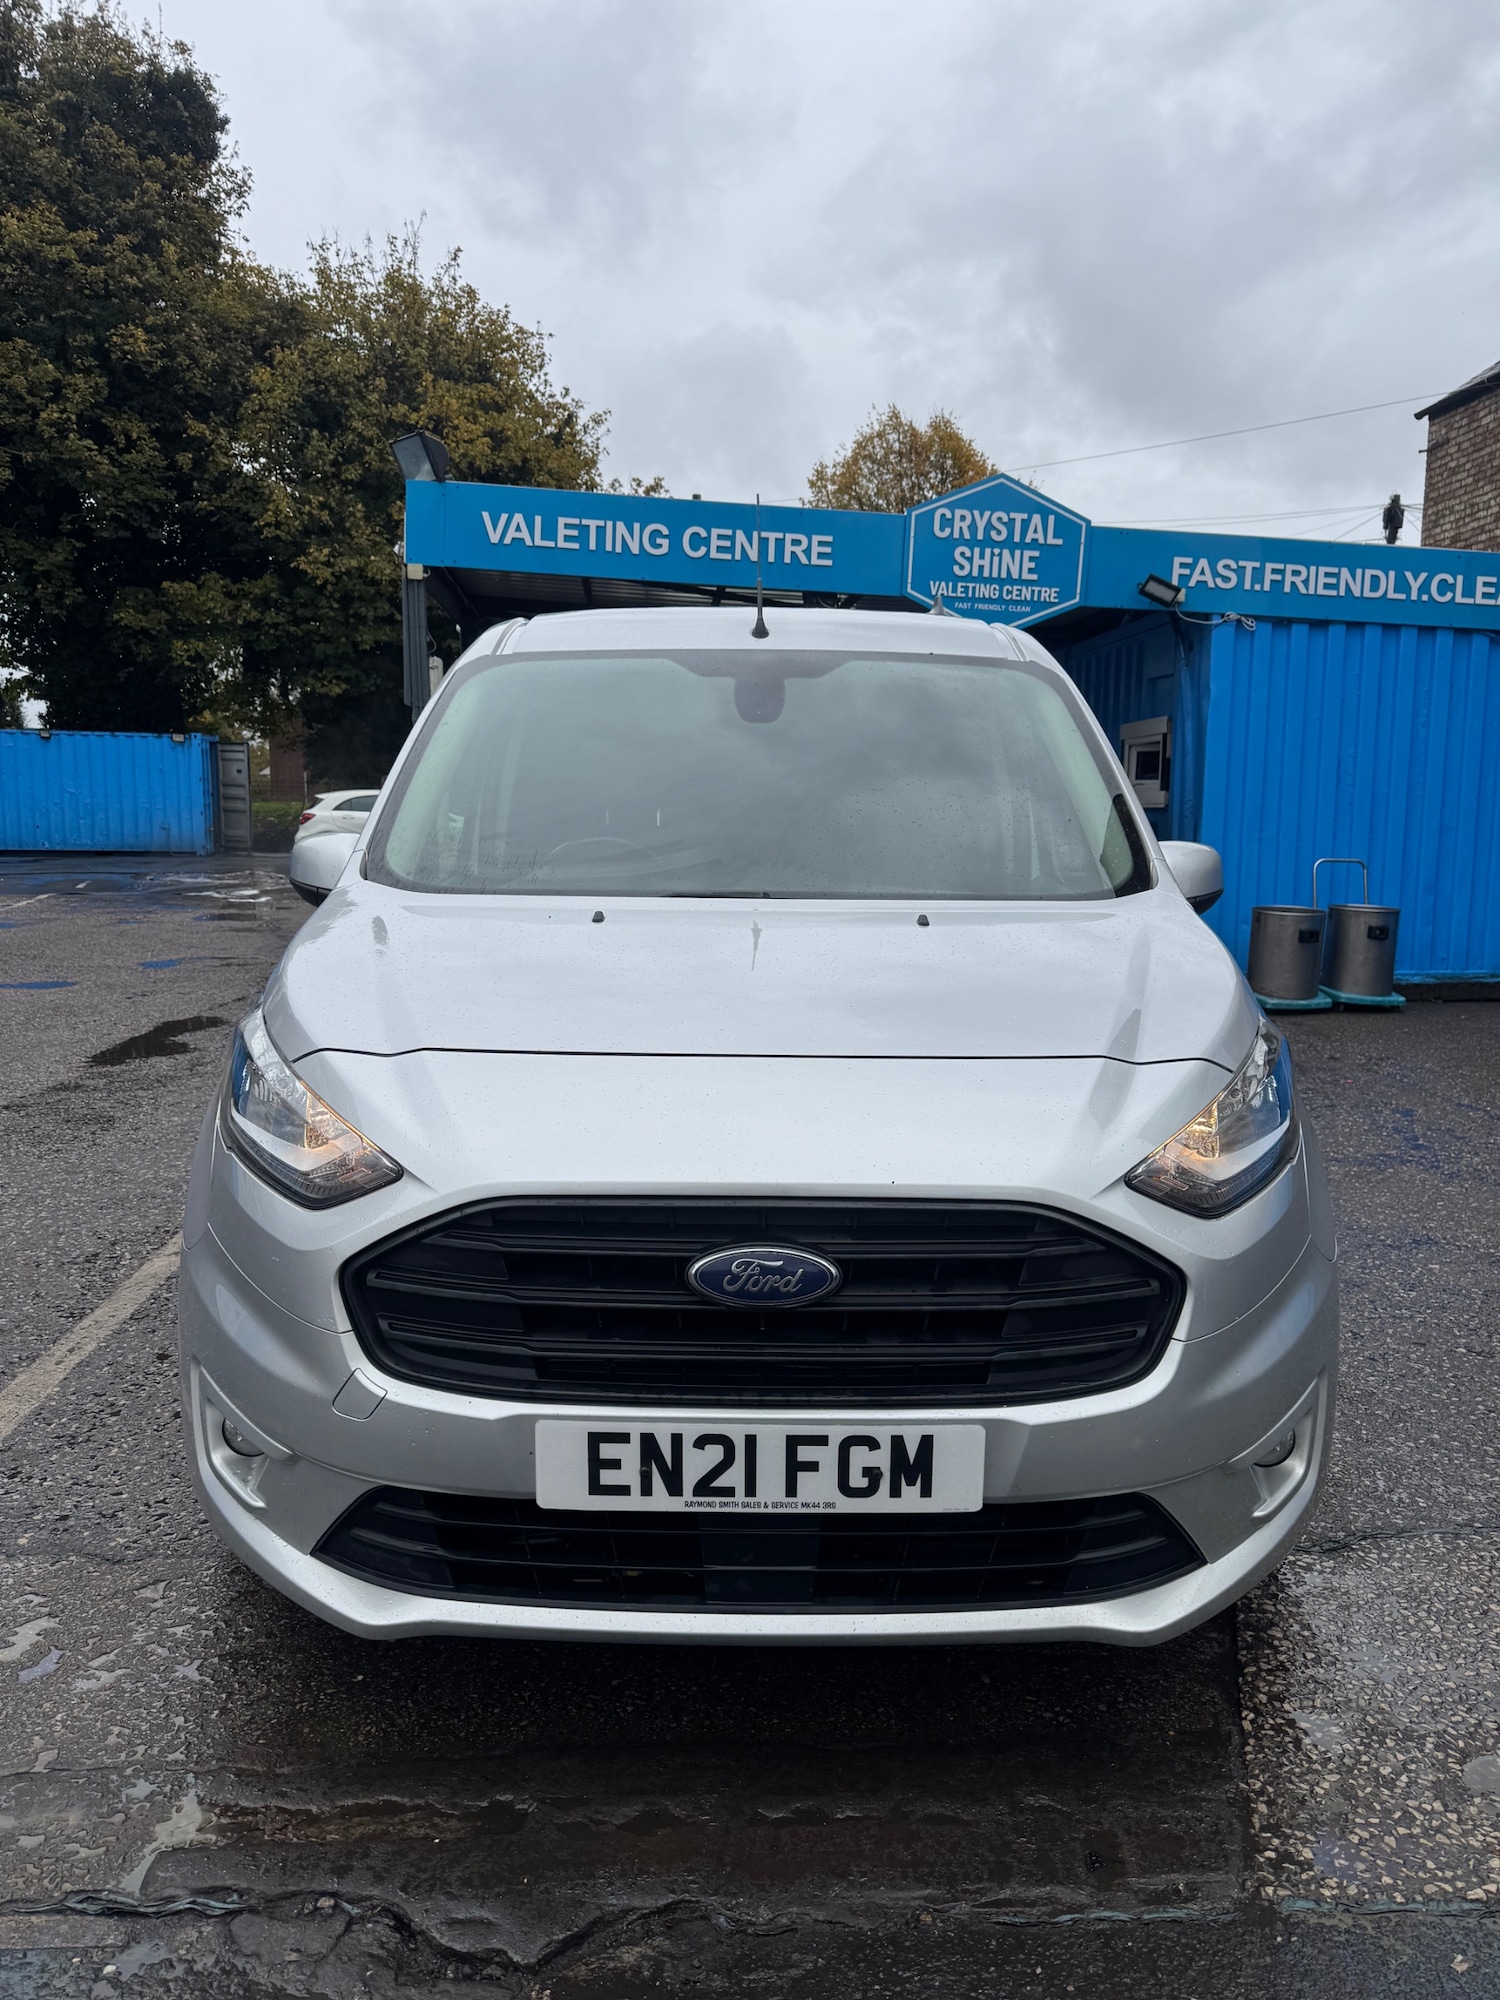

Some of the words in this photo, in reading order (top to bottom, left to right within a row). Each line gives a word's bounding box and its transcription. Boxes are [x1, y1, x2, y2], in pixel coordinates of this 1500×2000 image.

[481, 510, 670, 556] VALETING
[682, 525, 834, 567] CENTRE
[933, 507, 1064, 546] CRYSTAL
[929, 580, 1000, 600] VALETING
[1002, 585, 1060, 603] CENTRE
[1171, 556, 1500, 606] FAST.FRIENDLY.CLE
[954, 601, 972, 610] FAST
[974, 603, 1006, 612] FRIENDLY
[1008, 604, 1031, 613] CLEAN
[722, 1258, 804, 1293] Ford
[586, 1431, 758, 1498] EN21
[785, 1433, 935, 1499] FGM
[684, 1500, 717, 1509] RAYMOND
[718, 1500, 740, 1509] SMITH
[741, 1501, 762, 1509] SALES
[763, 1501, 770, 1509] &
[771, 1501, 799, 1510] SERVICE
[800, 1501, 821, 1510] MK44
